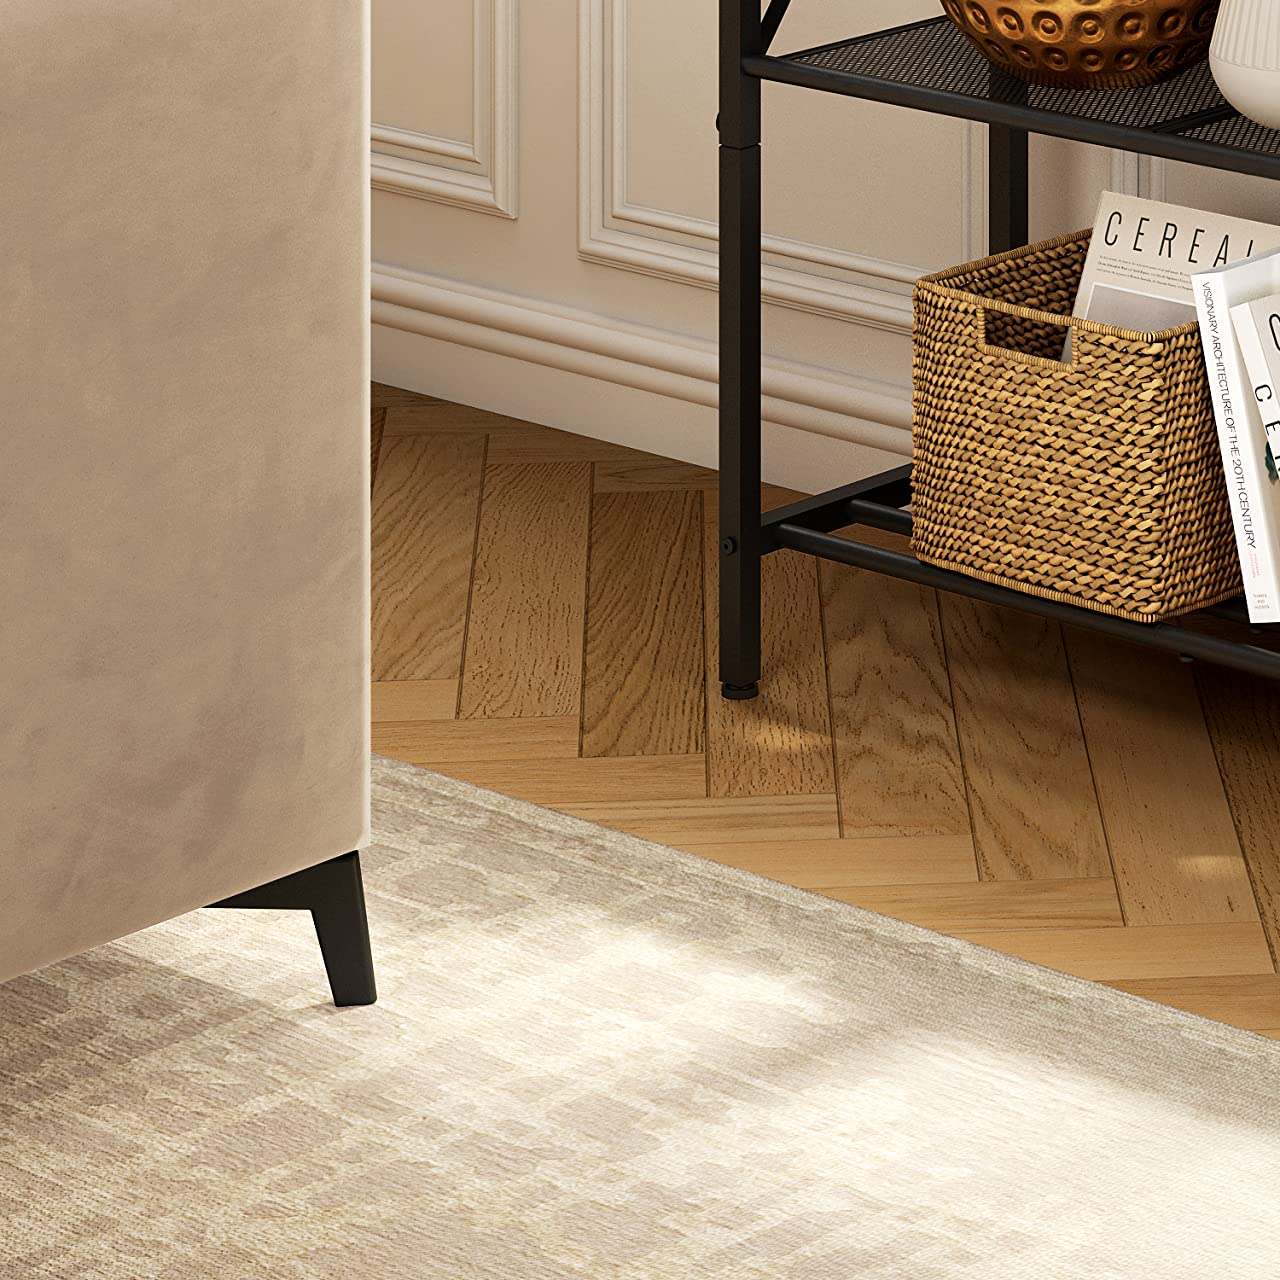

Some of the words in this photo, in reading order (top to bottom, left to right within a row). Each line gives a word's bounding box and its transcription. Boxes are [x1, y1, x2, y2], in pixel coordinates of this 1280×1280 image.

[1202, 281, 1219, 334] VISIONARY
[1211, 335, 1234, 416] ARCHITECTURE
[1225, 417, 1236, 433] OF
[1229, 434, 1241, 457] THE
[1239, 491, 1257, 549] CENTURY
